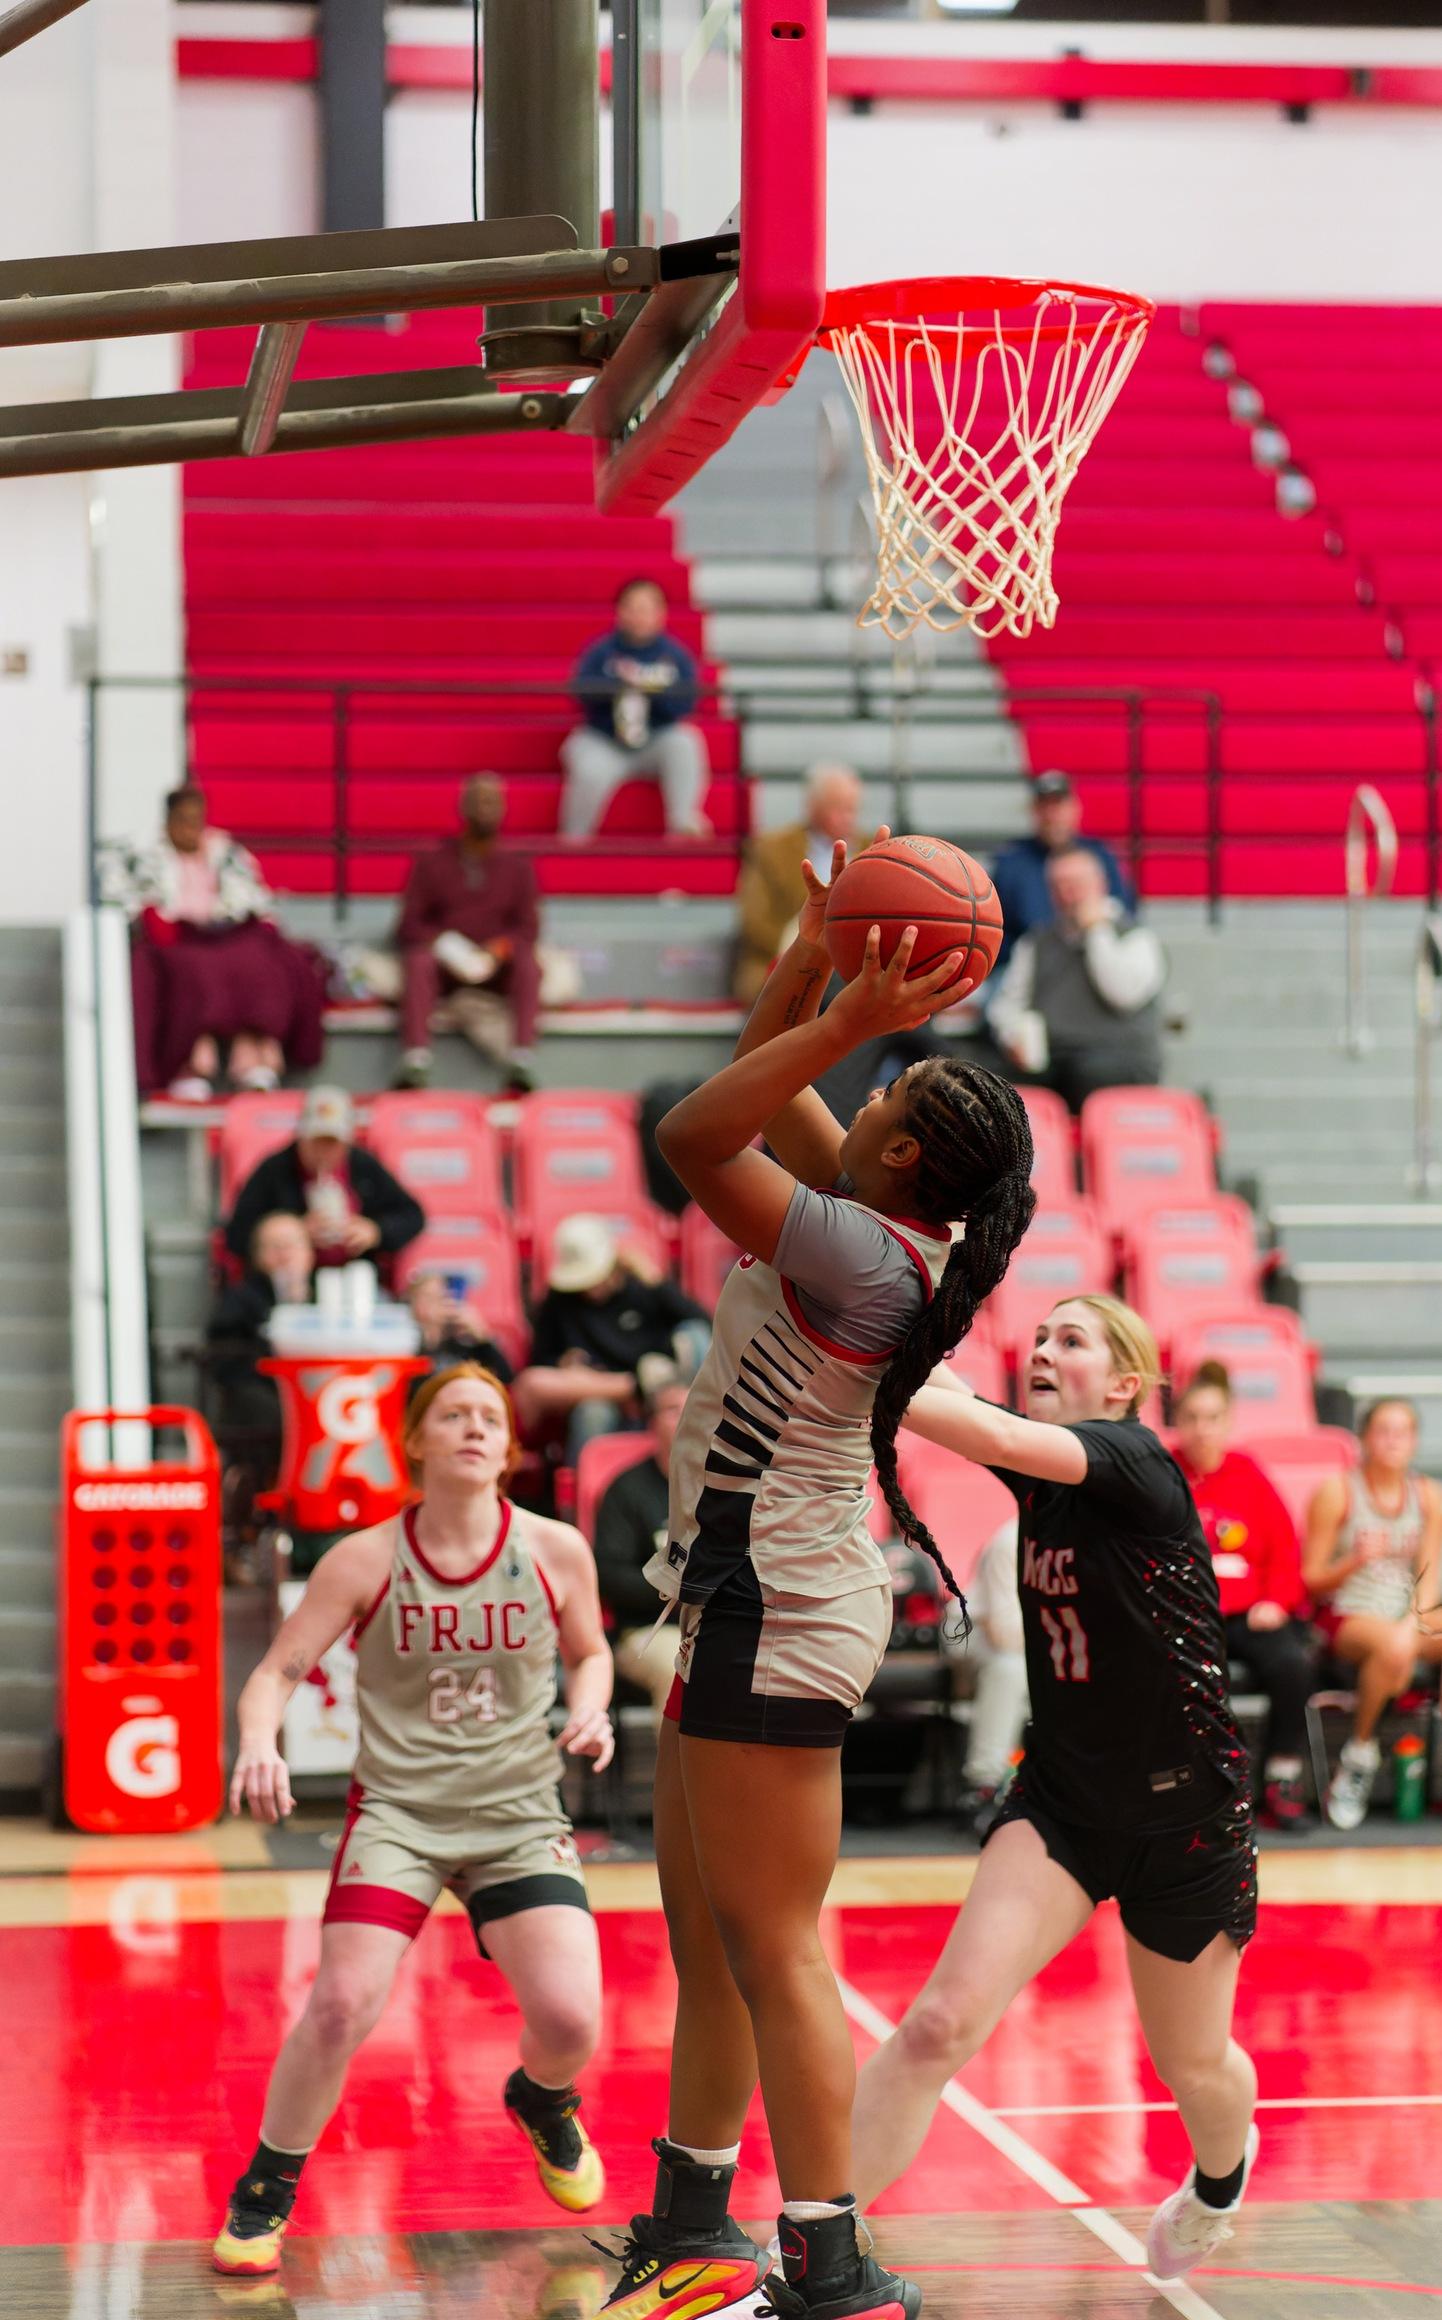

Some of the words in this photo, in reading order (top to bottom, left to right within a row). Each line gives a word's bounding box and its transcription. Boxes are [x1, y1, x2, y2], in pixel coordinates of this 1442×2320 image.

[317, 1375, 380, 1444] G
[396, 1601, 529, 1655] FRJC
[1039, 1604, 1091, 1683] 11
[427, 1666, 499, 1724] 24
[105, 1716, 181, 1799] G
